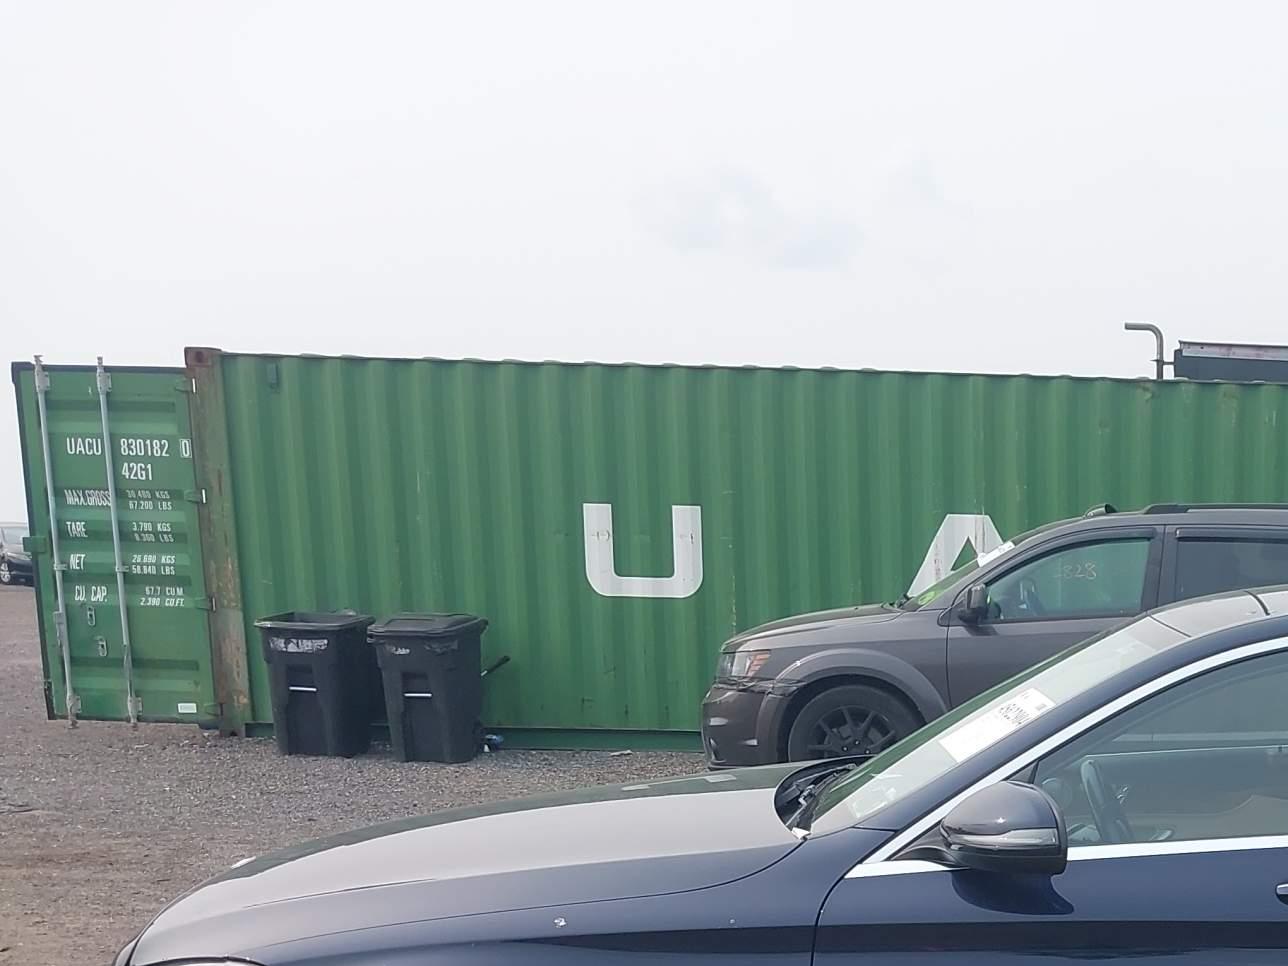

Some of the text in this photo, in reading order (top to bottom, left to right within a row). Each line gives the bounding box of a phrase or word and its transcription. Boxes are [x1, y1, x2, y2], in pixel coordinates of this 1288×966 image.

[66, 437, 102, 456] UACU
[120, 438, 170, 457] 830182
[122, 462, 153, 480] 42G1
[158, 501, 172, 510] LBS
[66, 521, 88, 537] TARE
[157, 522, 171, 532] KGS
[583, 503, 703, 598] U
[69, 554, 85, 570] NET
[161, 555, 176, 564] KGS
[161, 566, 176, 576] LBS
